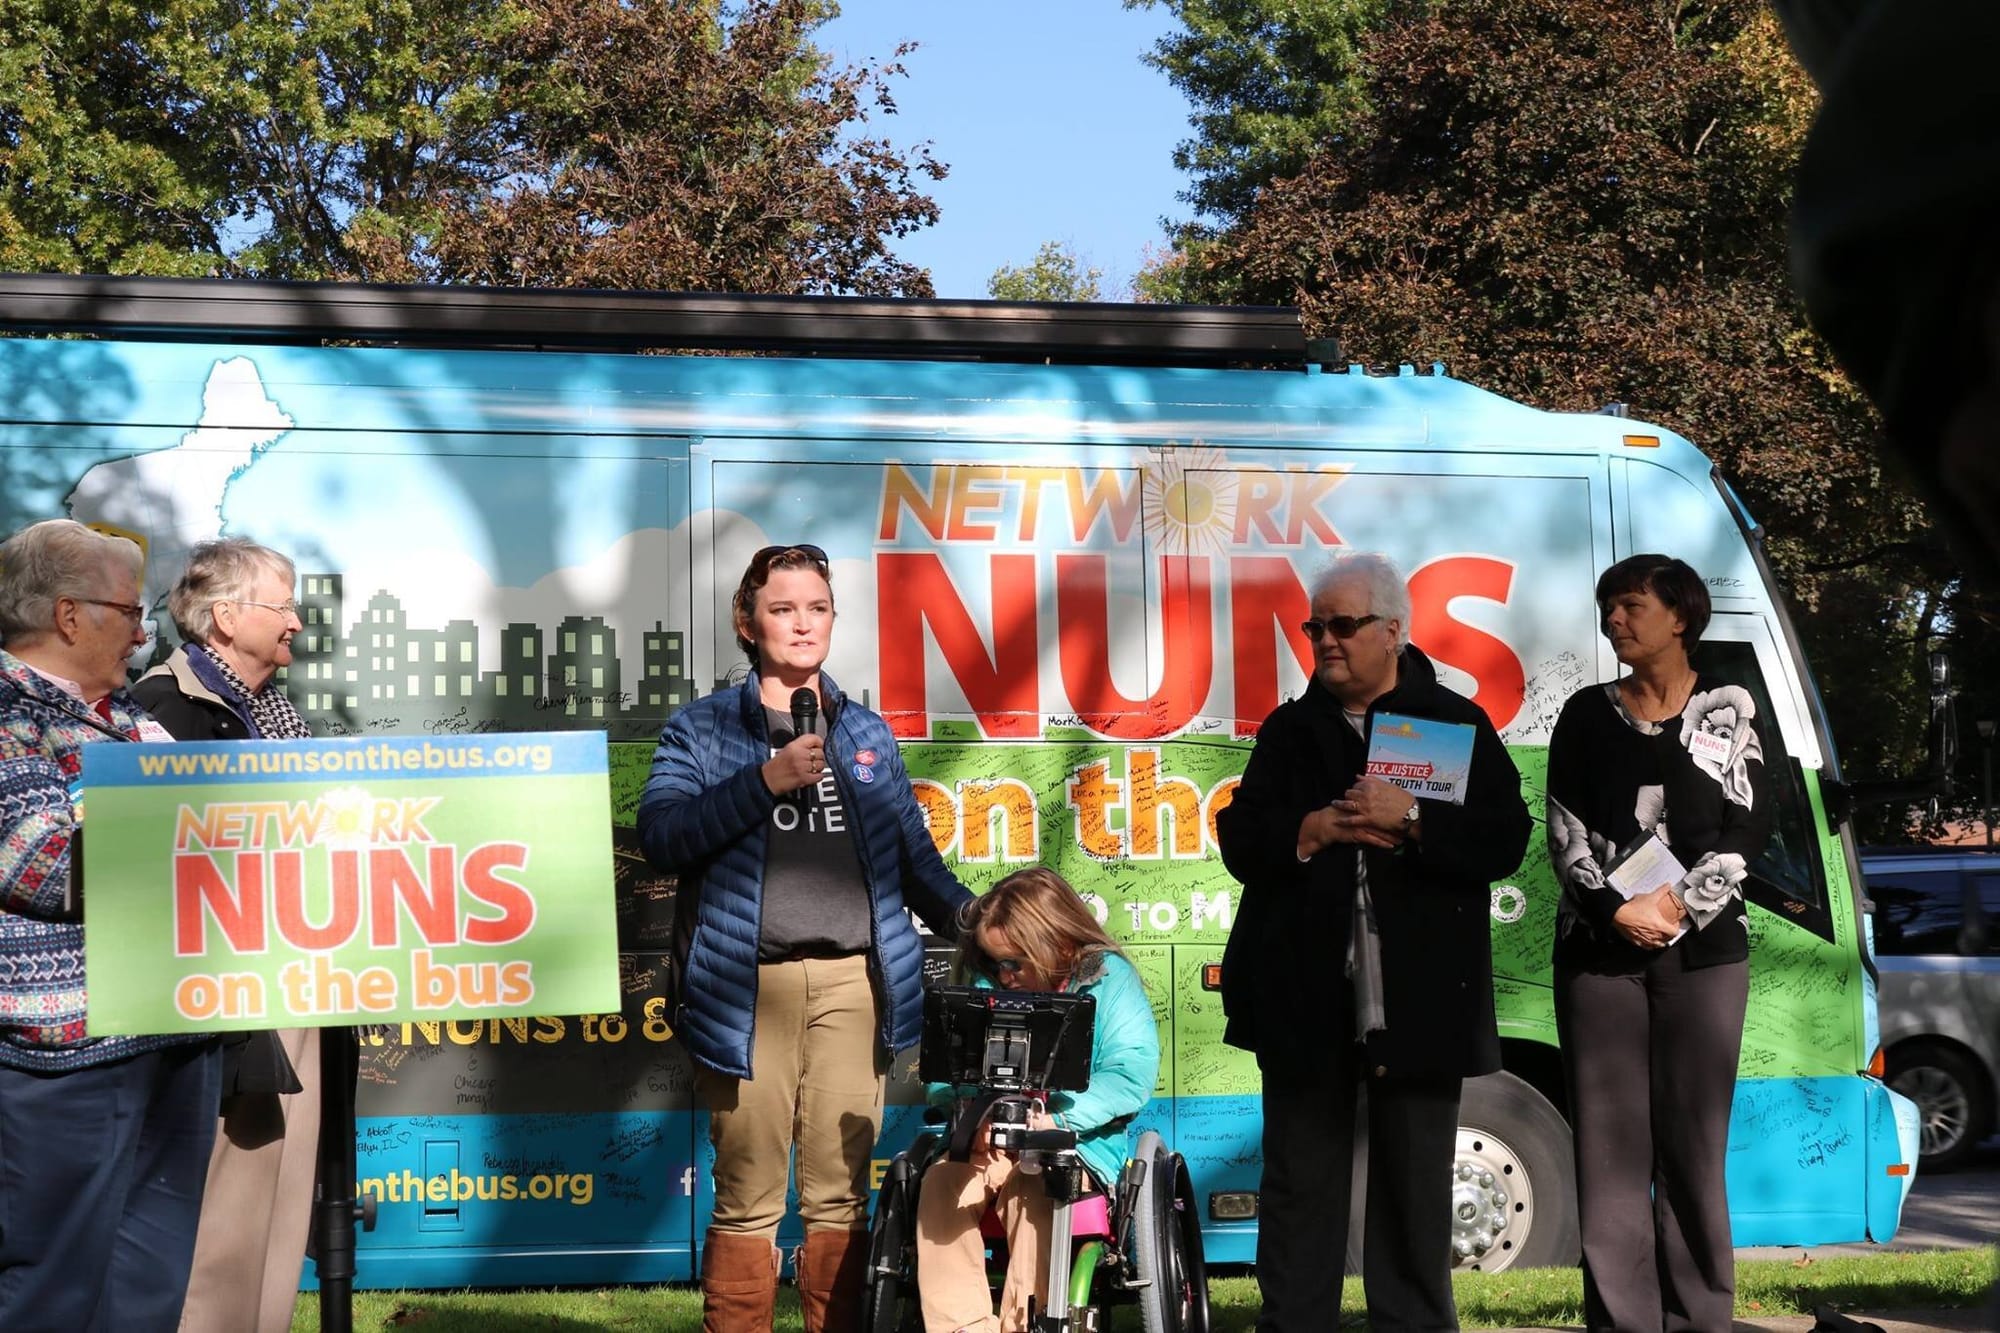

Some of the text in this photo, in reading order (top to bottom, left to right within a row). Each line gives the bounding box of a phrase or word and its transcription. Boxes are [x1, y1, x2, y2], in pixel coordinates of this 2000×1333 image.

[1695, 735, 1727, 753] NUNS
[140, 744, 552, 778] www.nunsonthebus.org
[1367, 763, 1387, 775] TAX
[773, 803, 845, 833] OTE
[174, 842, 537, 957] NUNS
[175, 950, 533, 1019] on the bus
